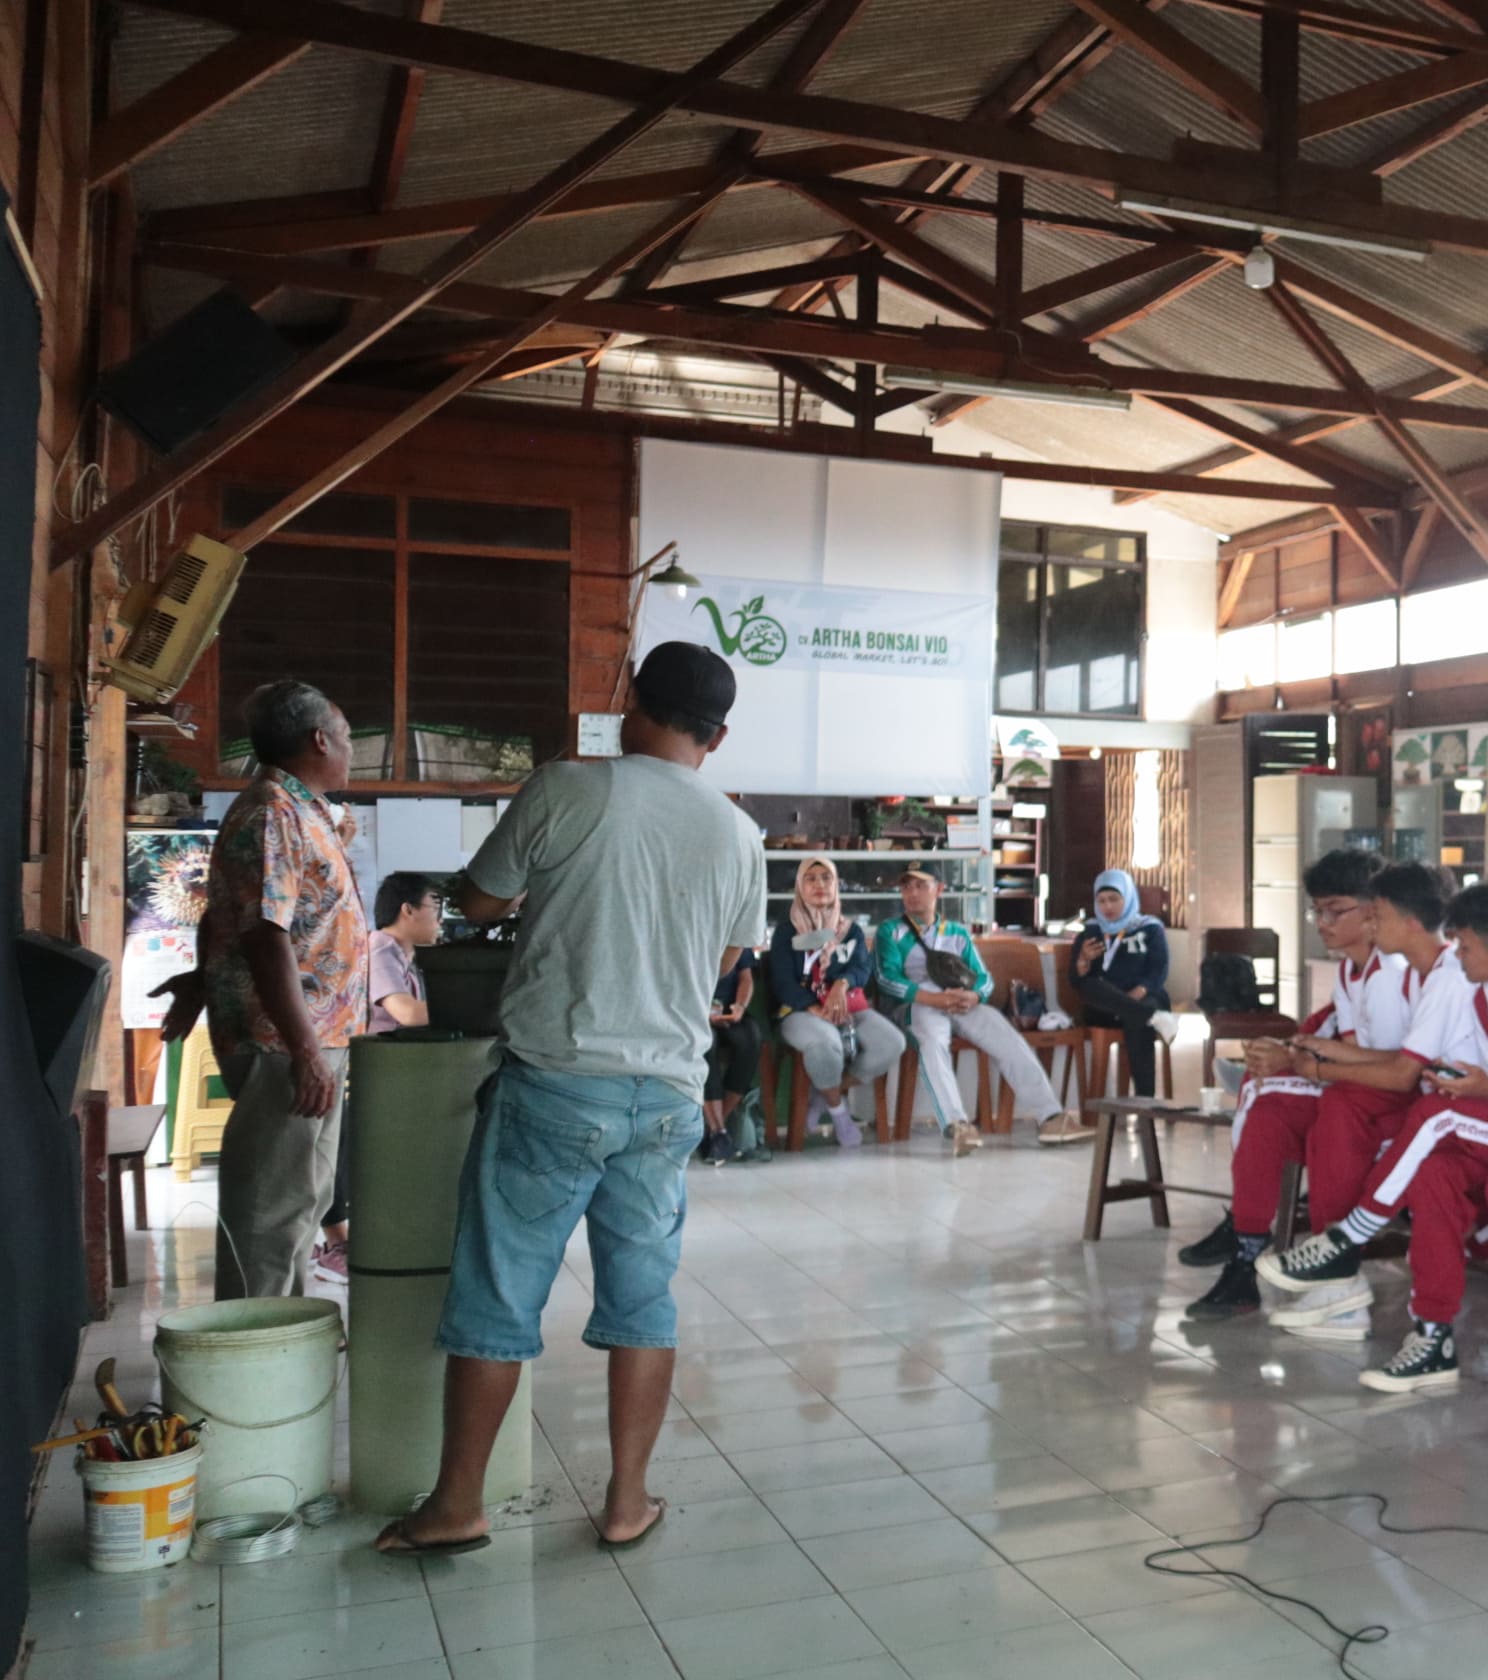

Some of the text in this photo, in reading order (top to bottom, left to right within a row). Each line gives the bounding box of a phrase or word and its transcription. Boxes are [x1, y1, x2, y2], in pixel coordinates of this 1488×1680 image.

[811, 628, 861, 649] ARTHA
[866, 631, 920, 652] BONSAI
[925, 635, 948, 654] VIO
